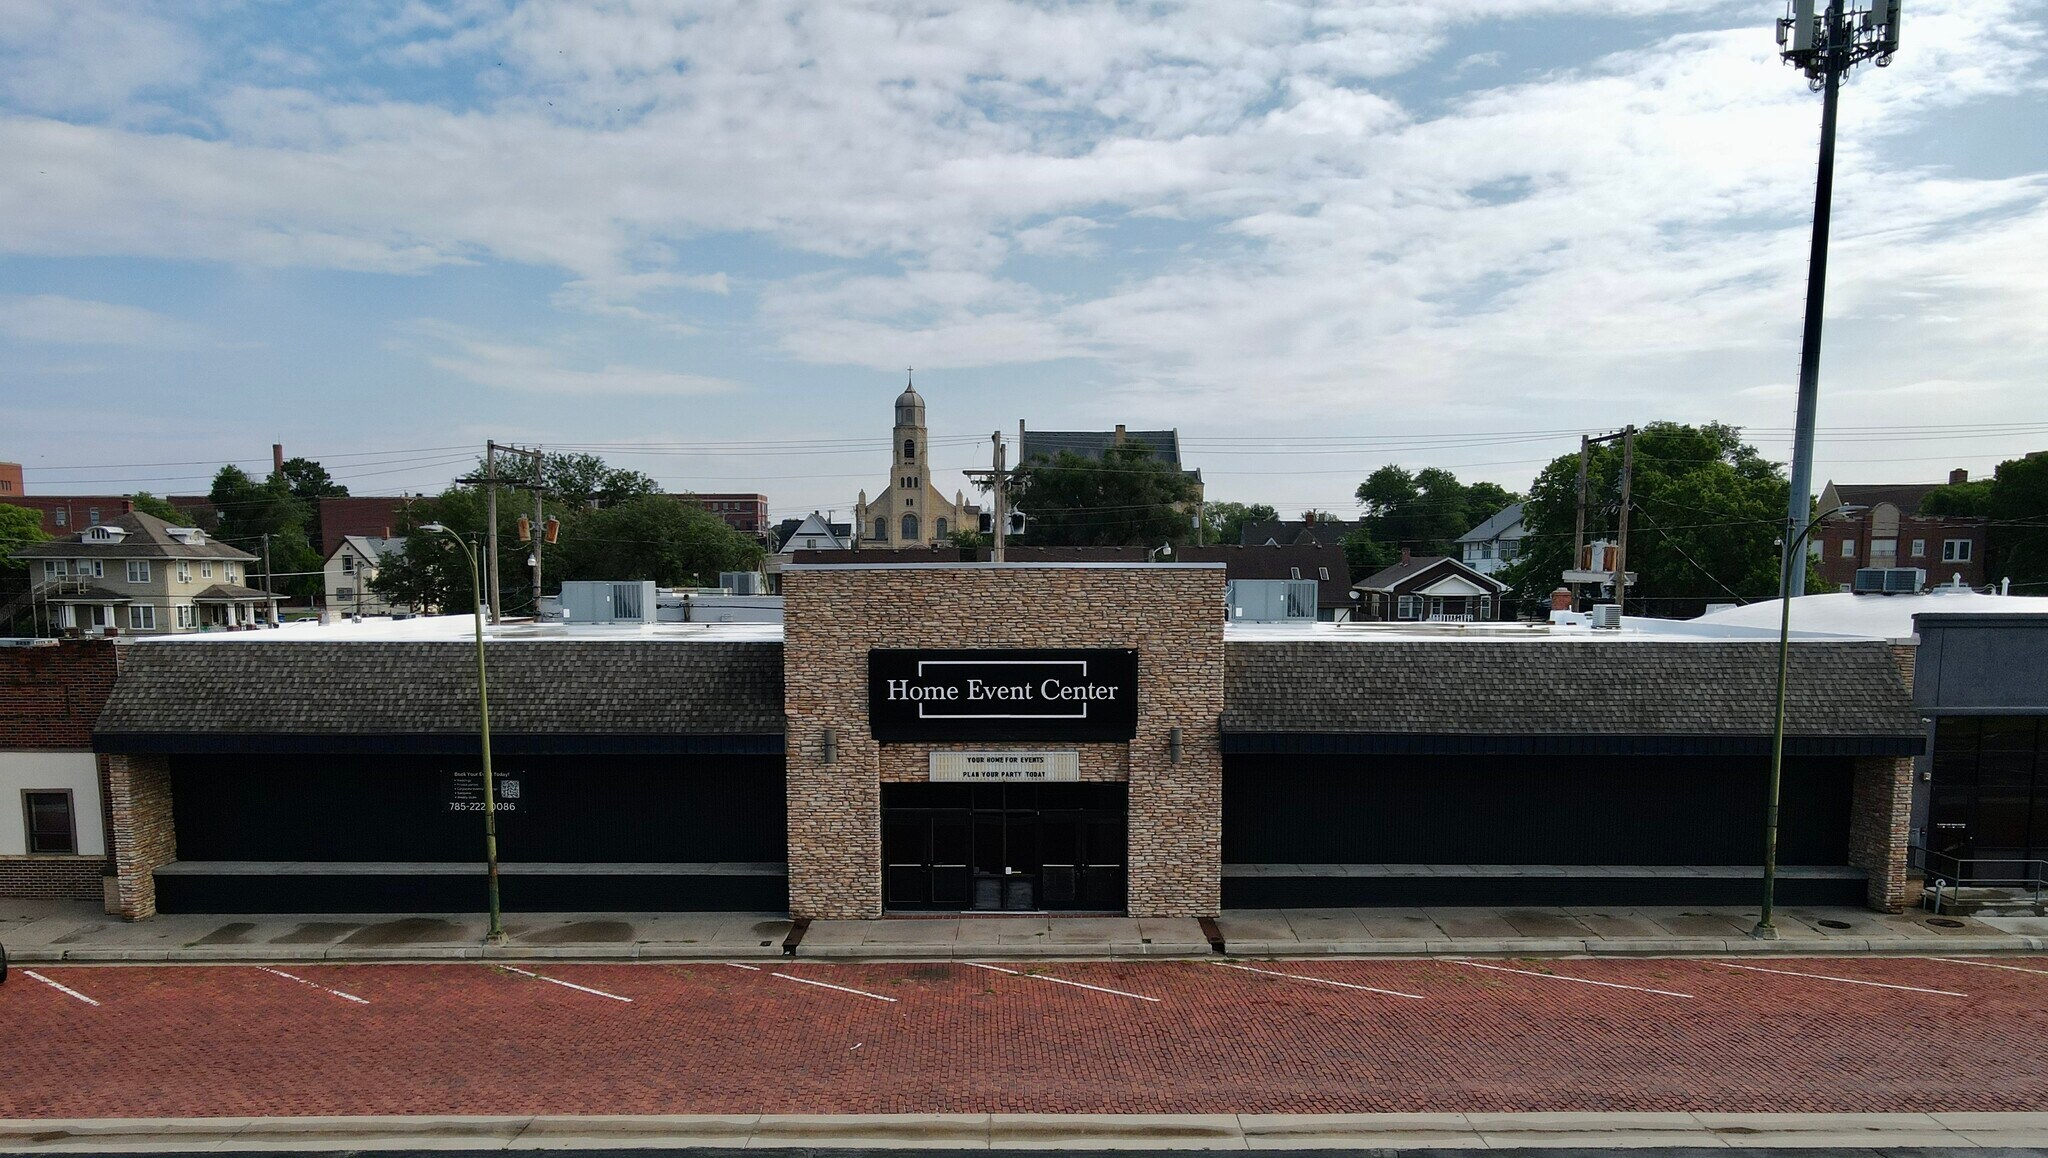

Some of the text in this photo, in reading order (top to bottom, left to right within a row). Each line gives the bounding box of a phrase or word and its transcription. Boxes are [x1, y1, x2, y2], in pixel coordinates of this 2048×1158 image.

[887, 678, 1118, 701] Home Event Center
[449, 802, 516, 811] 785-2220086
